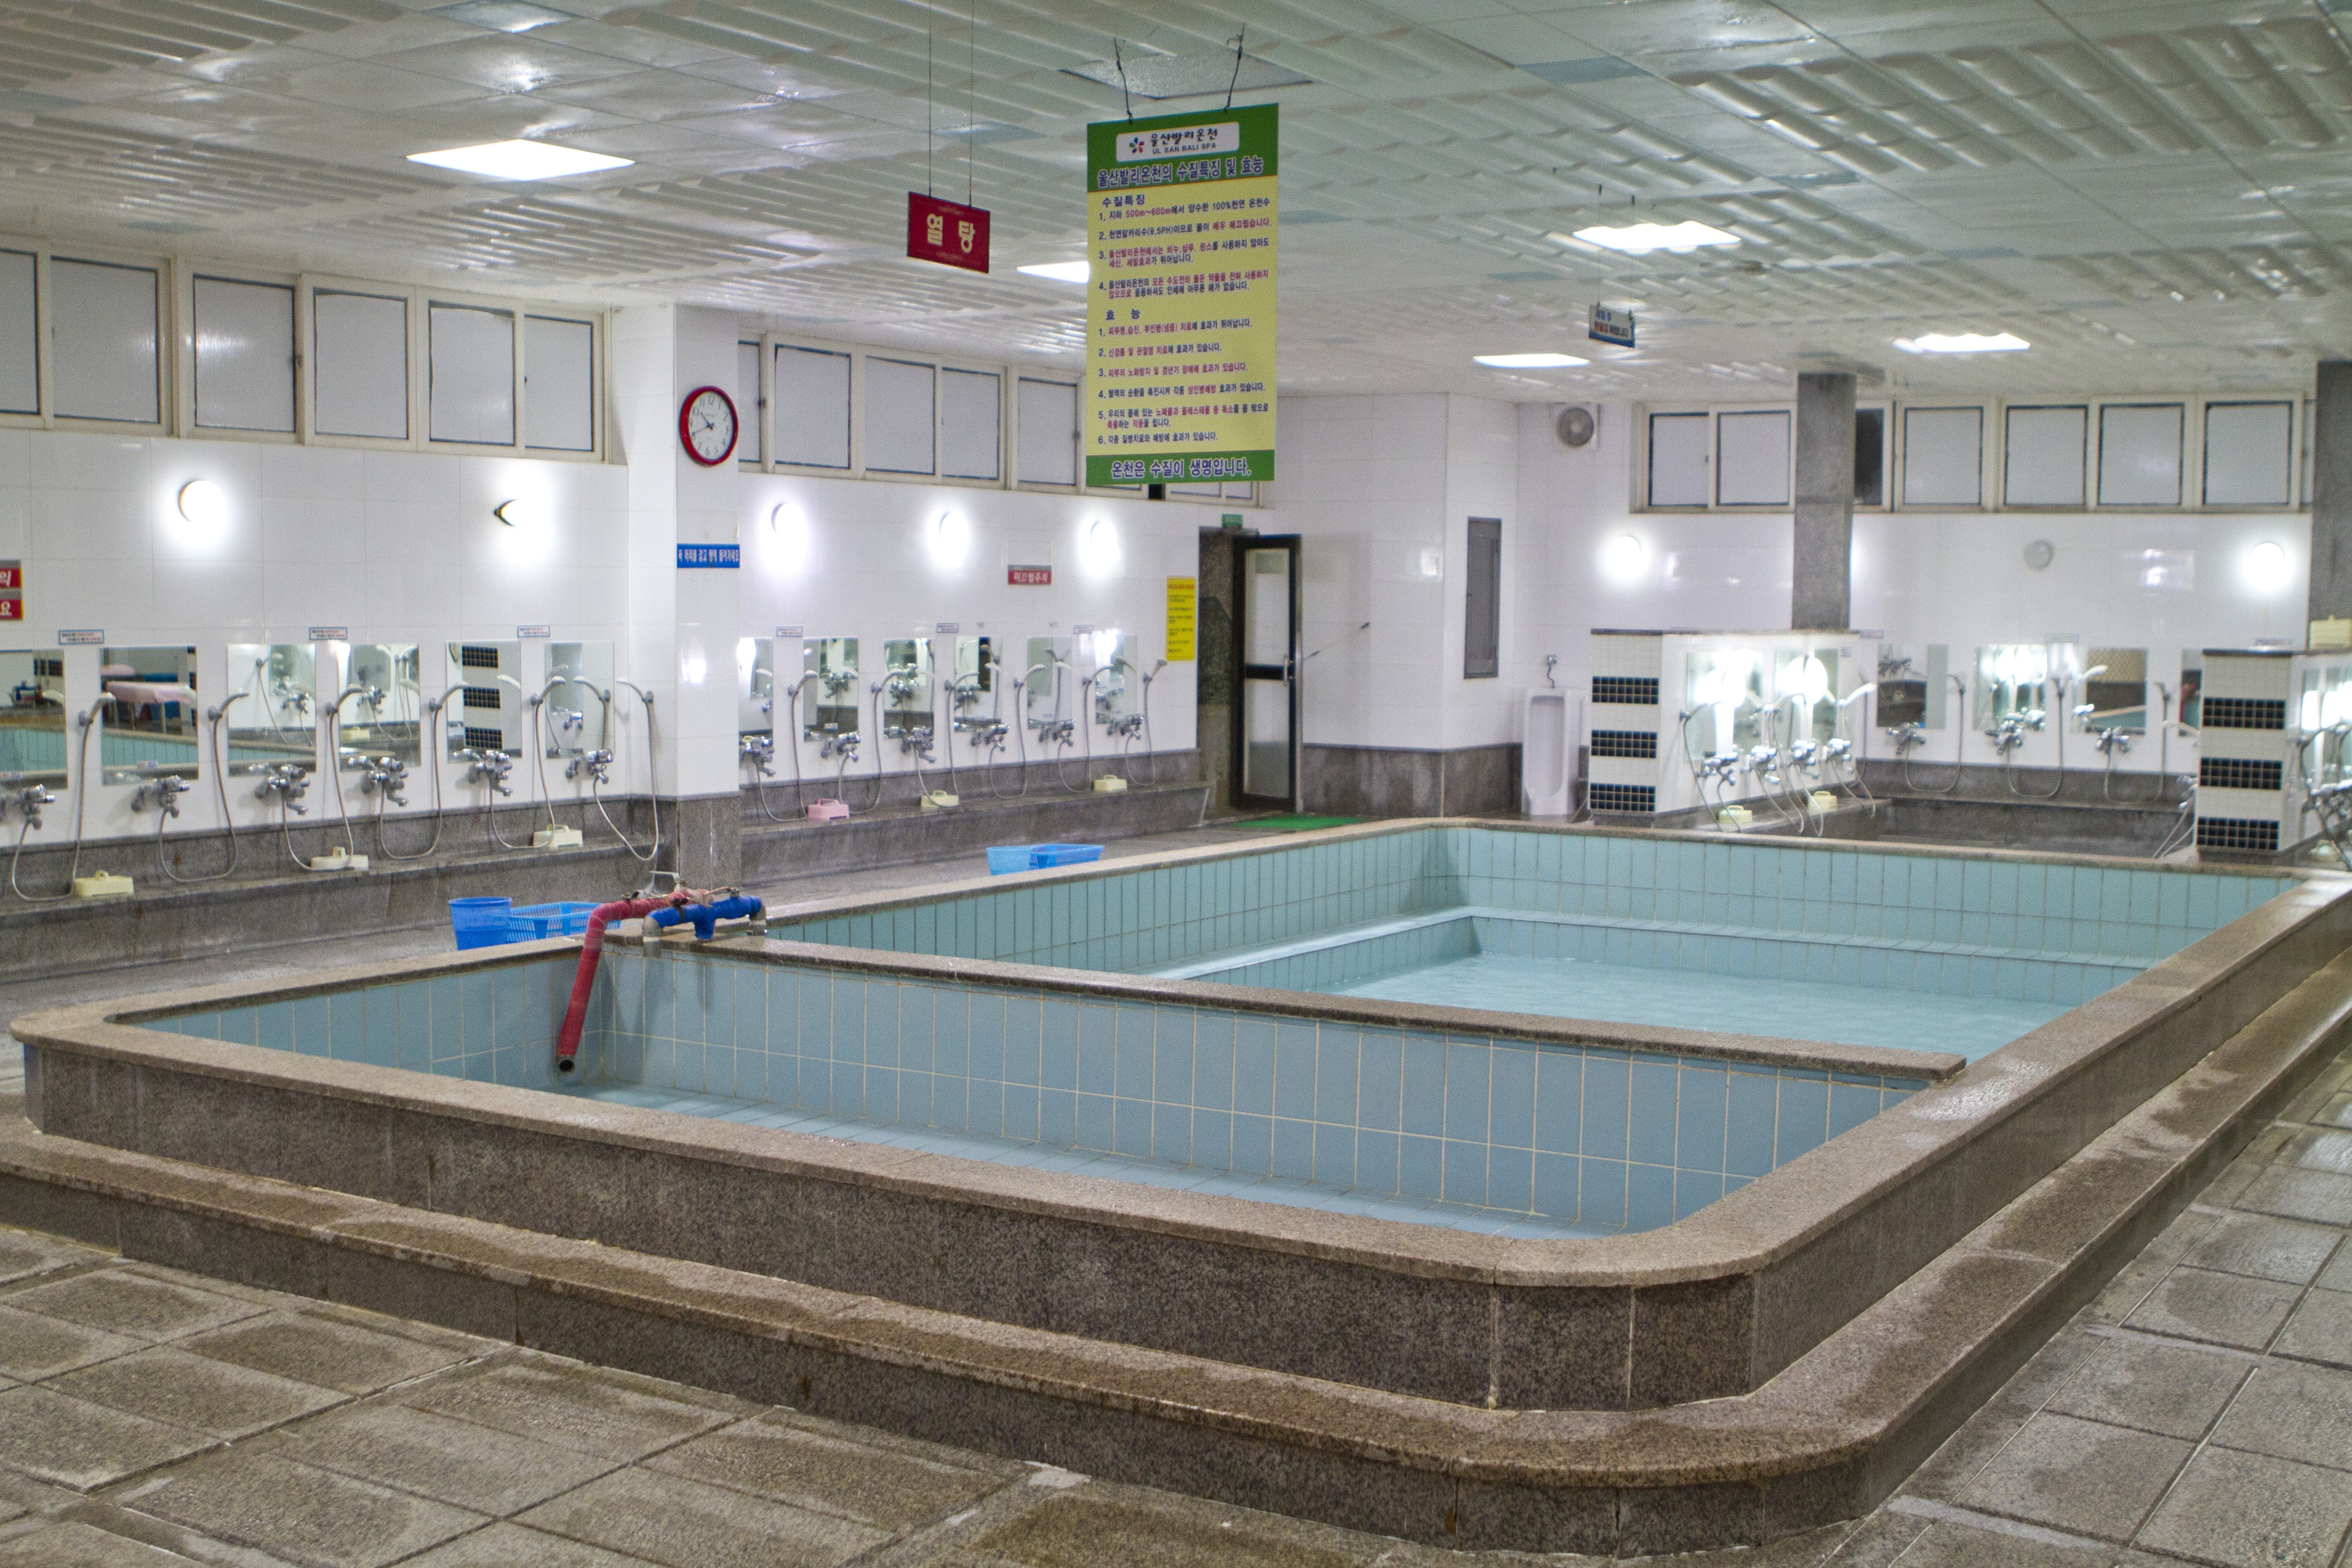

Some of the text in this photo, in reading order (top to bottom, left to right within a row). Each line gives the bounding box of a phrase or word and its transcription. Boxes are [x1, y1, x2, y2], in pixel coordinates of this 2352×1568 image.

[1151, 127, 1218, 147] 울산발리온천
[1098, 156, 1264, 188] 울산발리온천의 수질특징 및 효능
[1103, 194, 1145, 207] 수질특징
[1099, 212, 1105, 221] 1.
[1109, 210, 1122, 219] 지하
[1188, 202, 1209, 213] 양수한
[1212, 199, 1245, 210] 100%천연
[1249, 197, 1270, 208] 온천수
[1099, 342, 1222, 357] 2. 신경통 및 관절염 치료에 효과가 있습니다.
[700, 398, 705, 407] 11
[708, 395, 715, 405] 12
[724, 412, 729, 421] 2
[726, 425, 729, 434] 3
[721, 438, 726, 446] 4
[1098, 431, 1218, 444] 6. 각종 질병치료와 예방에 효과가 있습니다.
[698, 442, 702, 450] 7
[706, 447, 710, 455] 6
[1111, 457, 1251, 479] 온천은 수질이 생명입니다.
